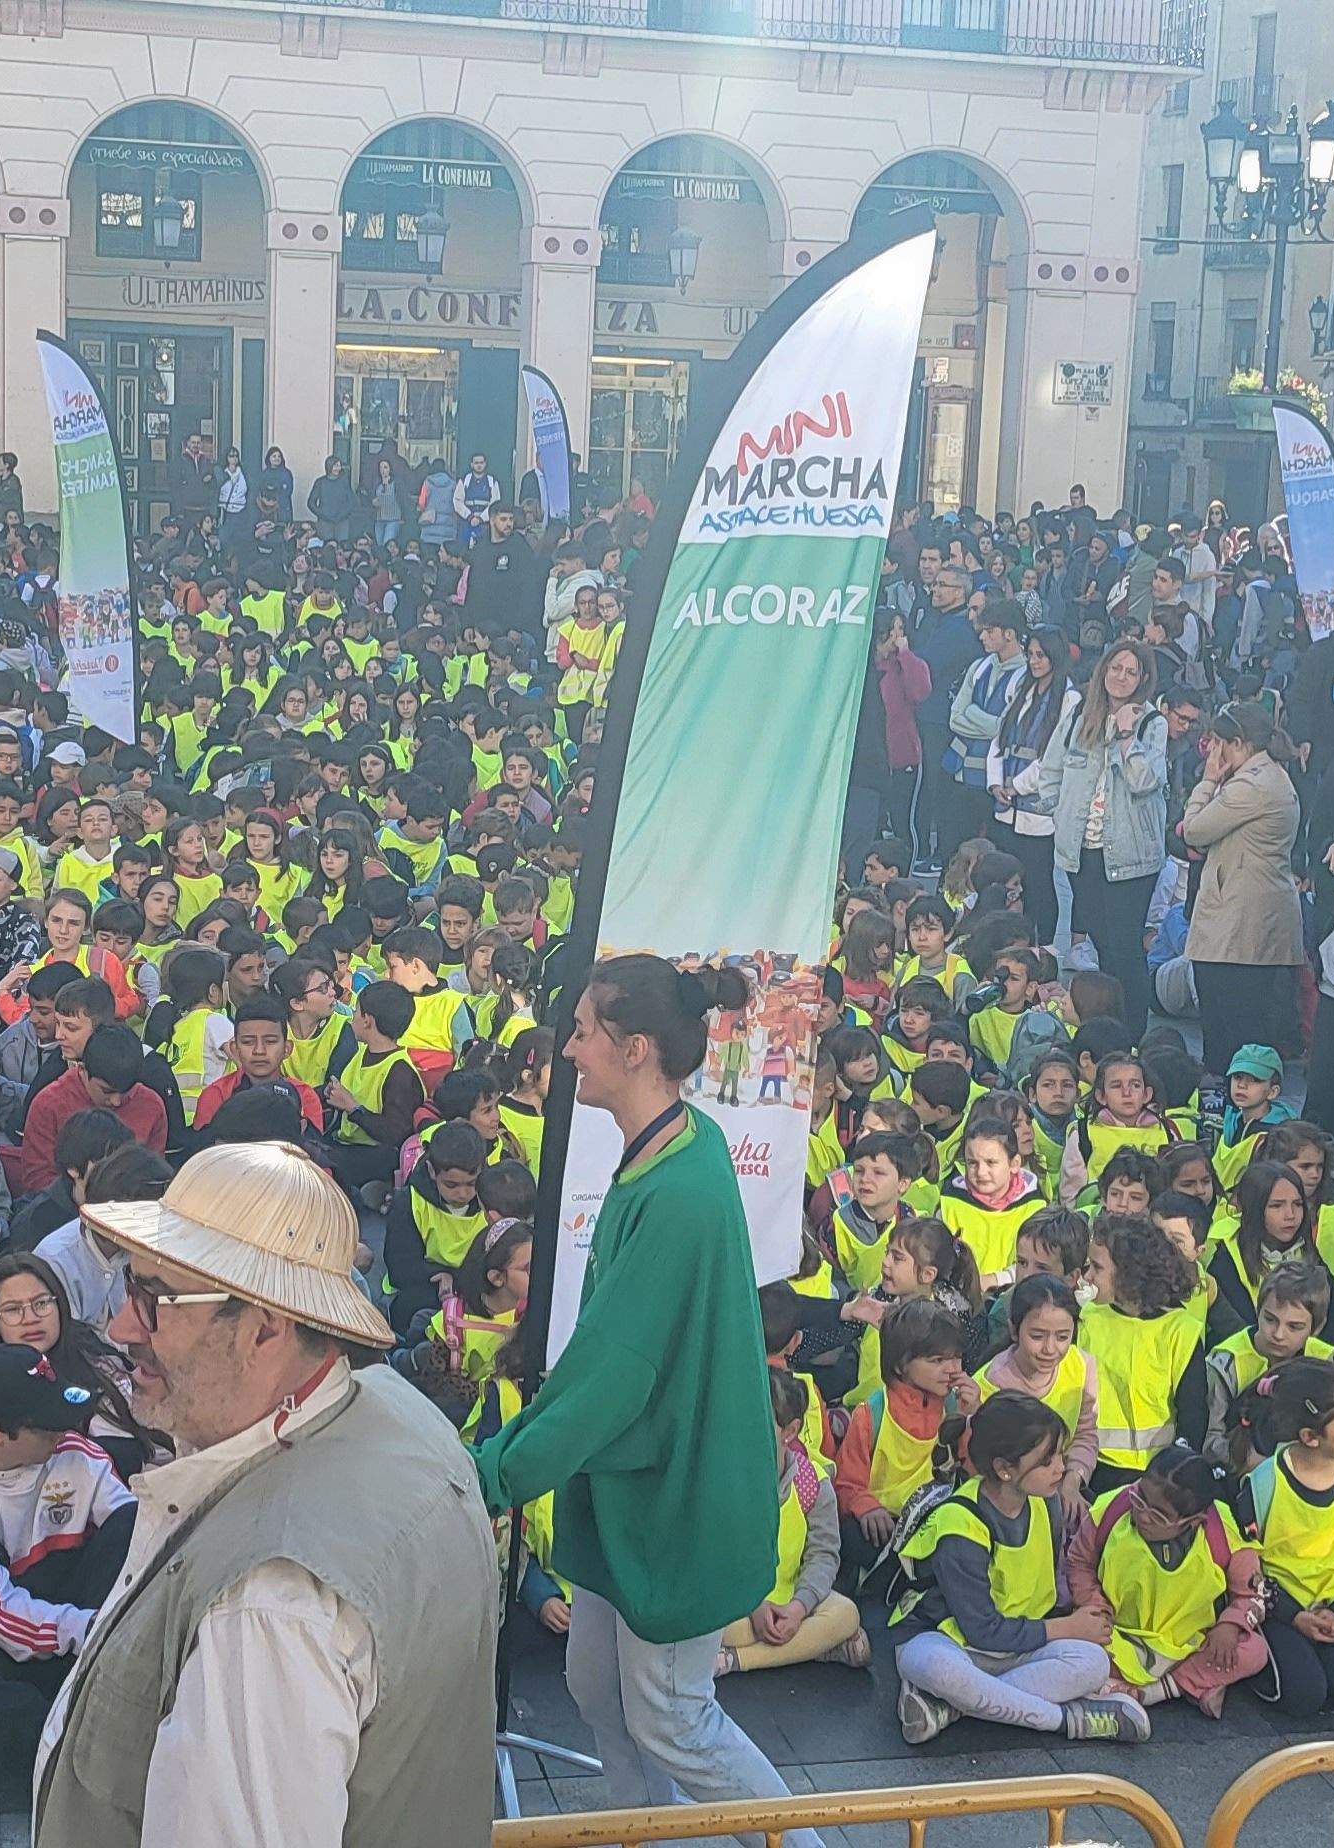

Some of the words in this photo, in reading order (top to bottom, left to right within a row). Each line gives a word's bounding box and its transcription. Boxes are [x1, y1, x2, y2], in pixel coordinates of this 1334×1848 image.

[89, 145, 132, 163] pruebe
[137, 150, 157, 162] sus
[162, 151, 244, 169] especialidades
[422, 164, 435, 184] LA
[438, 165, 492, 188] CONFIANZA
[673, 178, 687, 198] LA
[688, 179, 741, 201] CONFIANZA
[125, 275, 267, 307] ULTRAMARINOS
[595, 300, 660, 334] ZA
[737, 390, 853, 476] MINI
[701, 456, 889, 507] MARCHA
[793, 502, 885, 528] HUESCA
[671, 584, 870, 631] ALCORAZ
